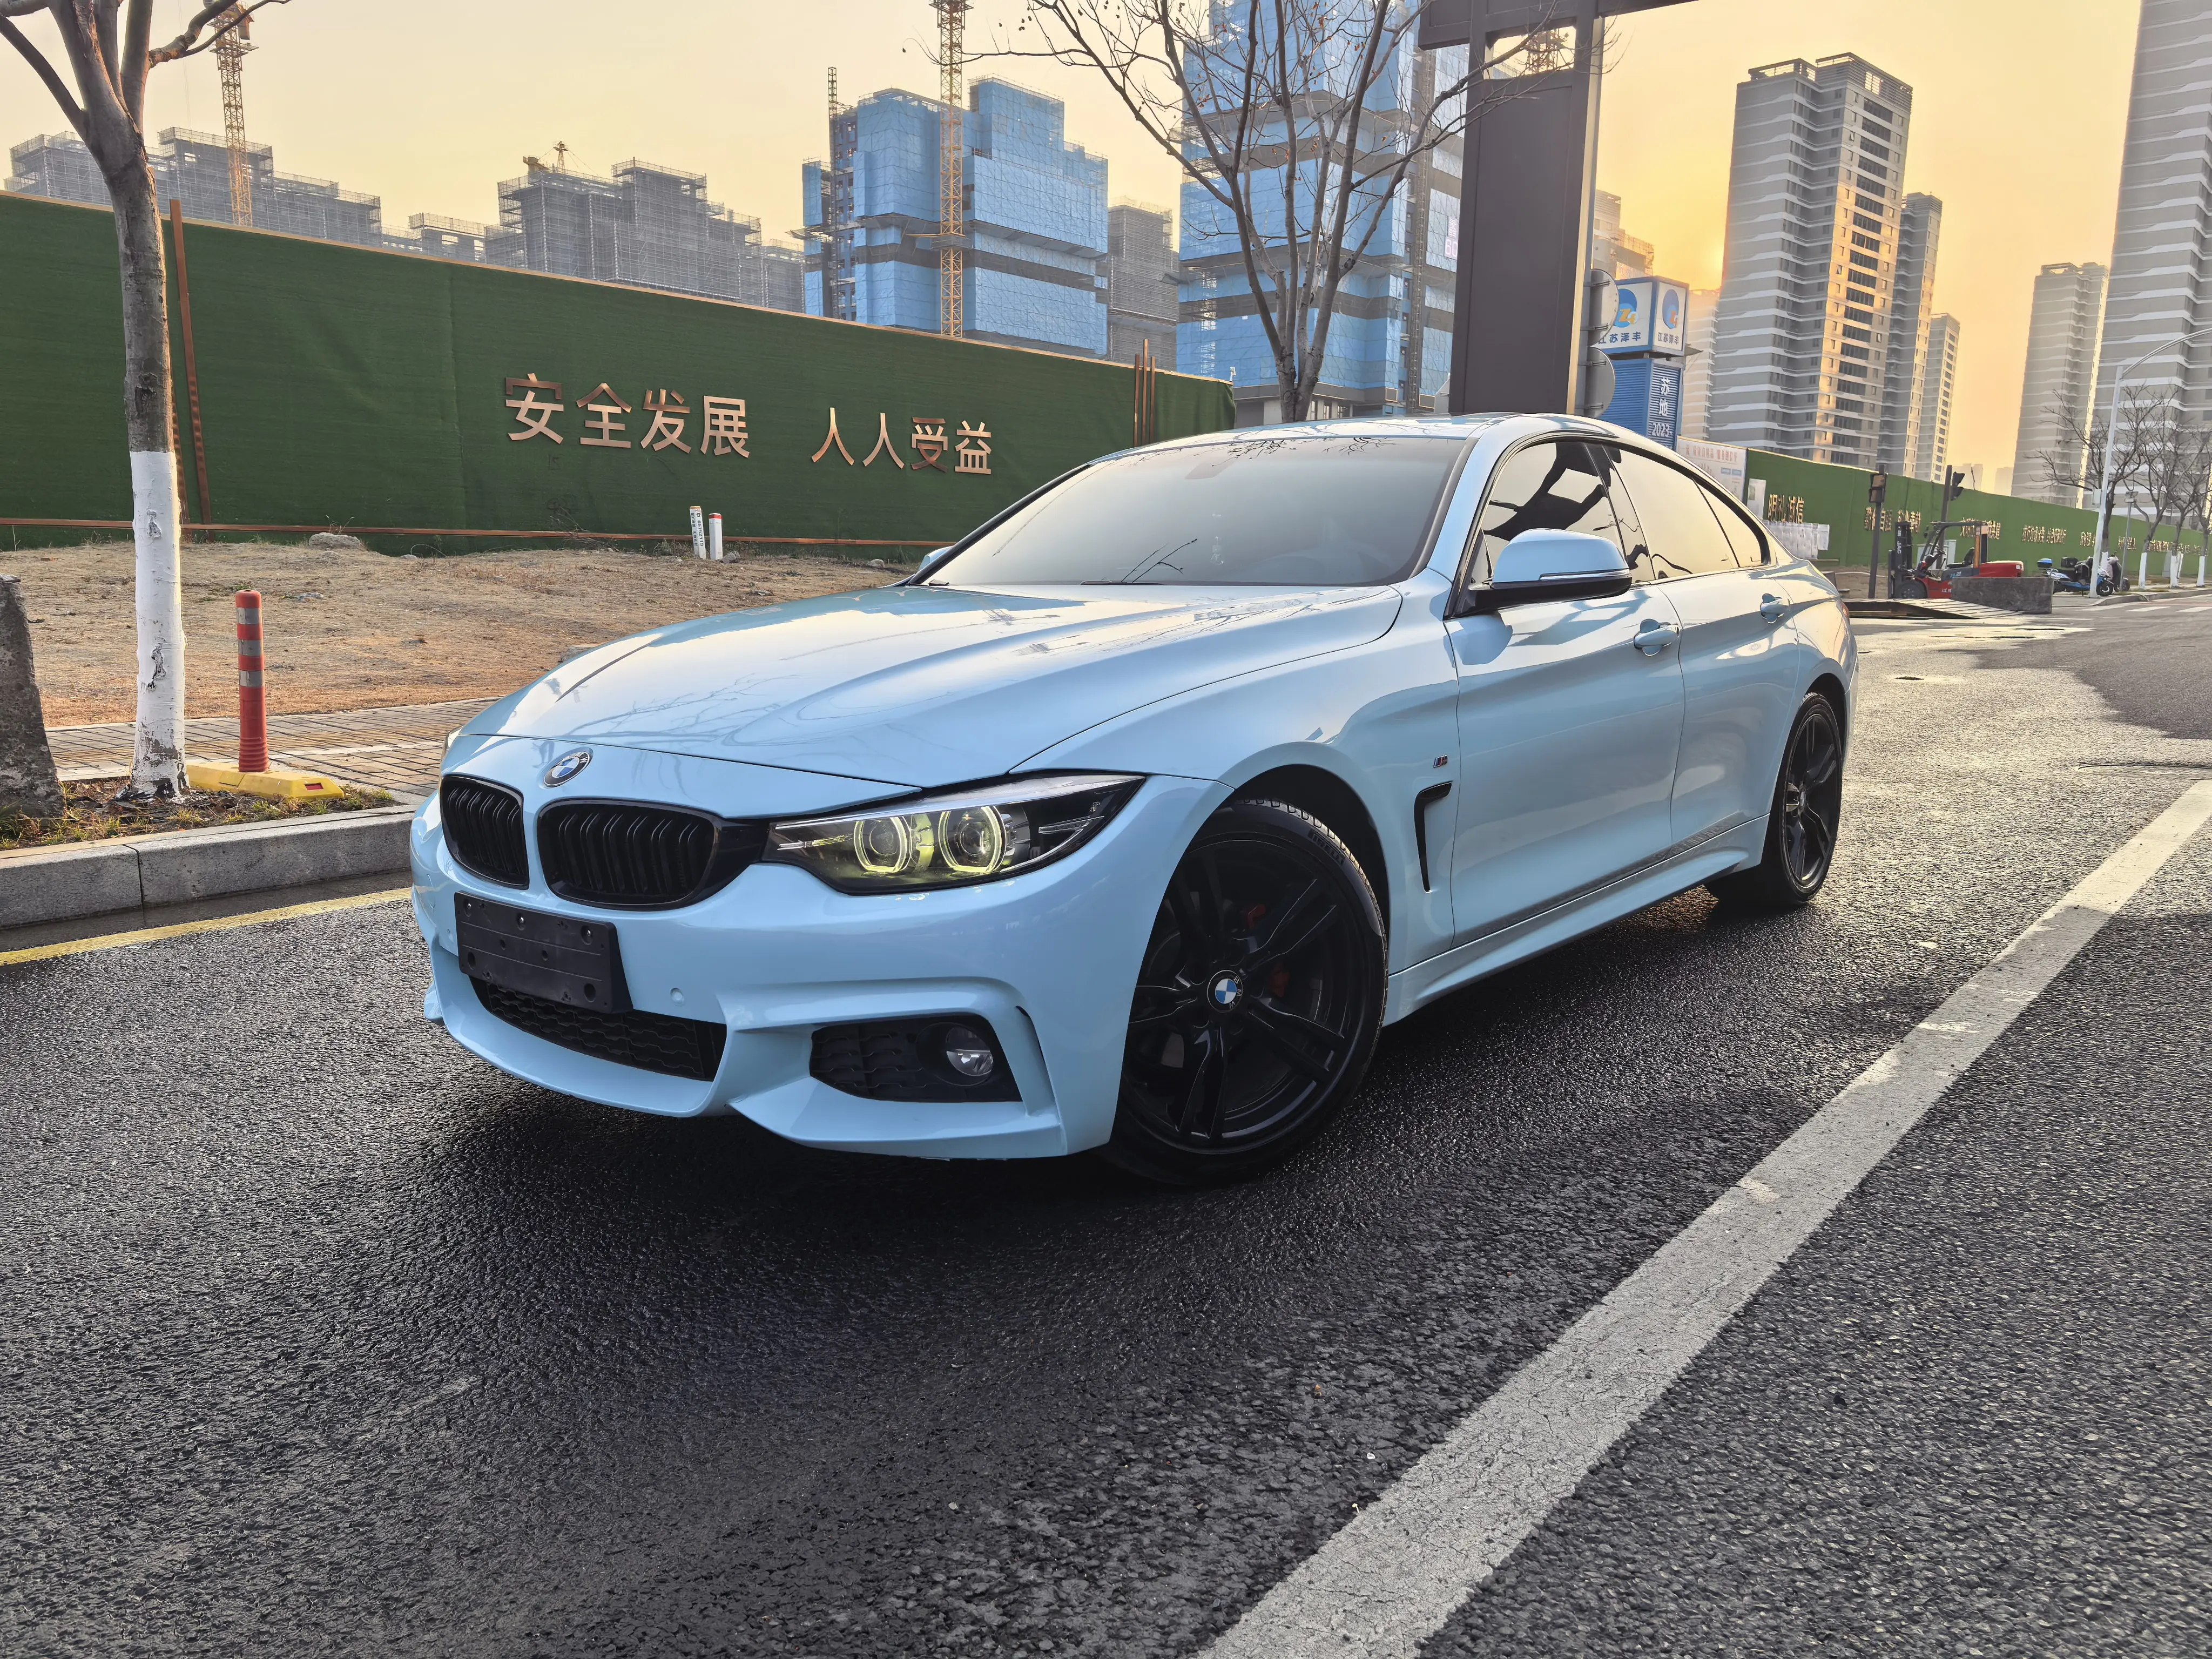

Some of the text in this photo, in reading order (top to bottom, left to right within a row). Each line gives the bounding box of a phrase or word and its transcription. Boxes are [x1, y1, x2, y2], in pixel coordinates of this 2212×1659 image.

[505, 373, 992, 475] 安全发展 人人受益
[1229, 975, 1242, 1009] BMW
